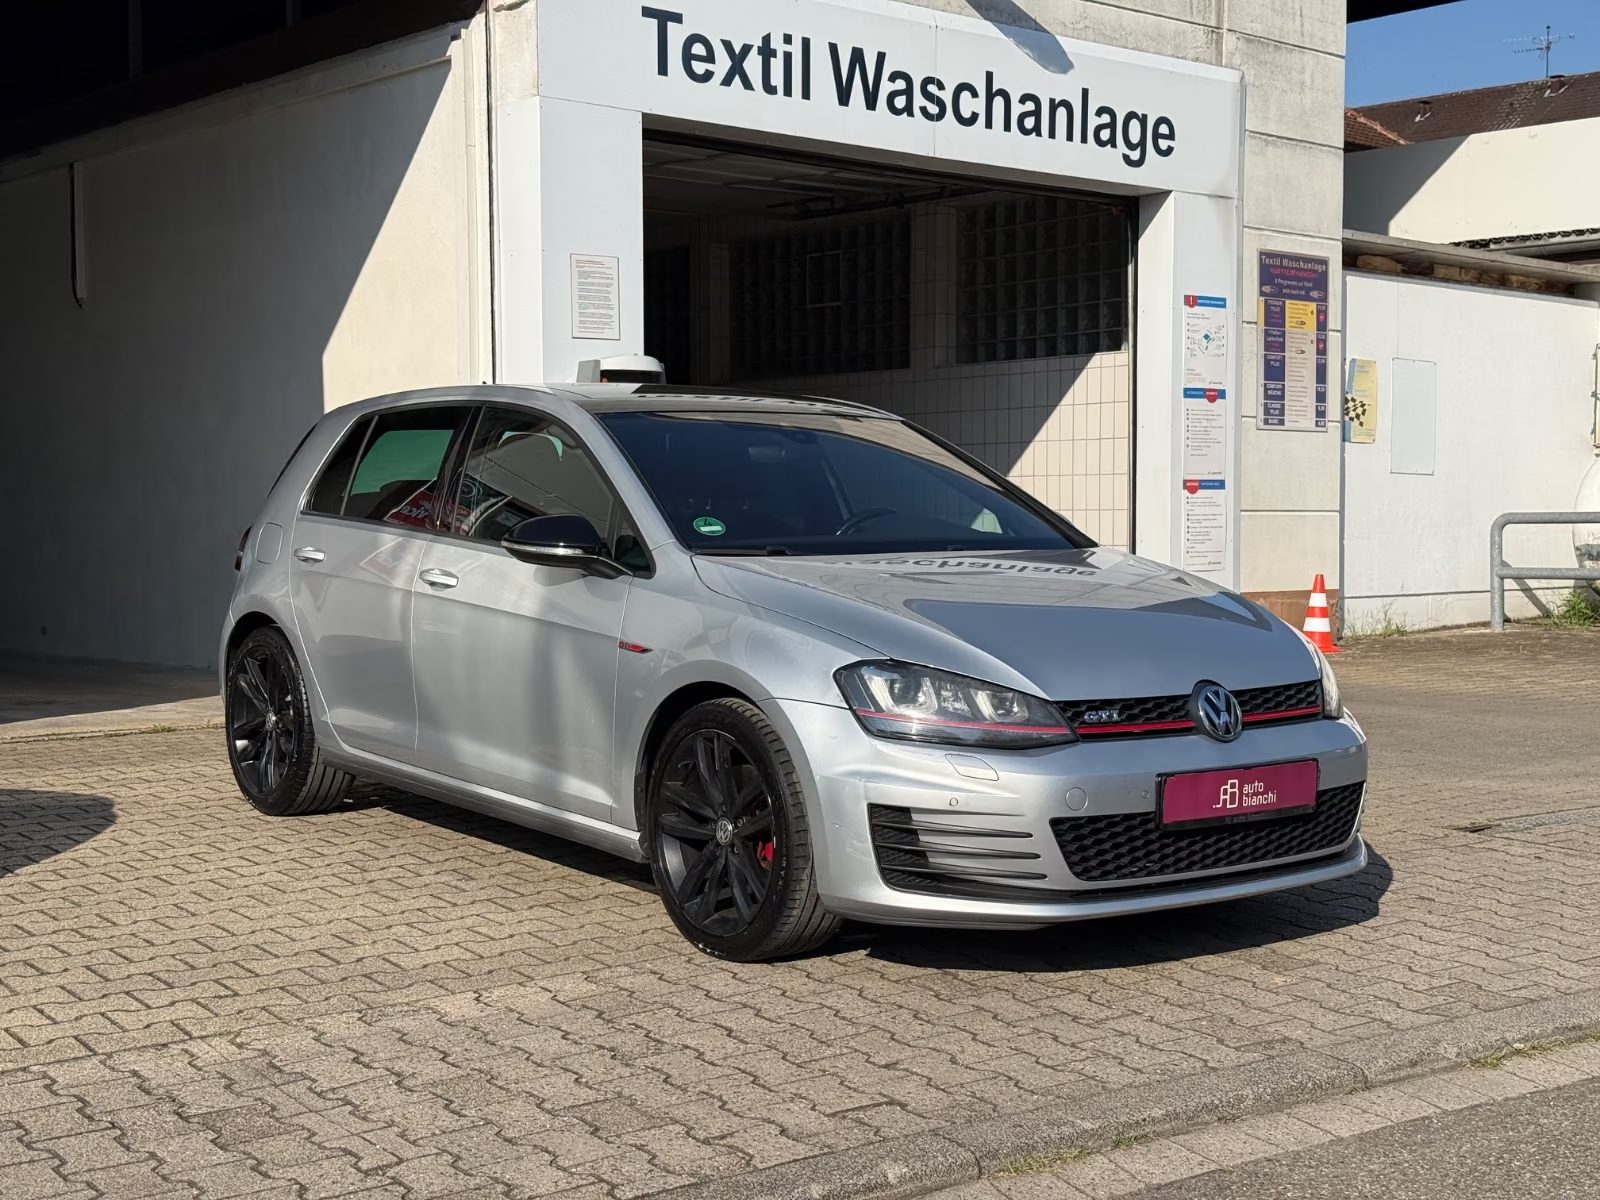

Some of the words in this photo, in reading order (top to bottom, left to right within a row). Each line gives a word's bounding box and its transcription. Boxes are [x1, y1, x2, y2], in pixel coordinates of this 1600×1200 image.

[642, 6, 811, 101] Textil
[828, 42, 1176, 168] Waschanlage
[1261, 255, 1281, 266] Textil
[1282, 258, 1327, 273] Waschanlage
[1083, 709, 1121, 722] GTI
[1242, 780, 1264, 794] auto
[1242, 790, 1277, 807] bianchi
